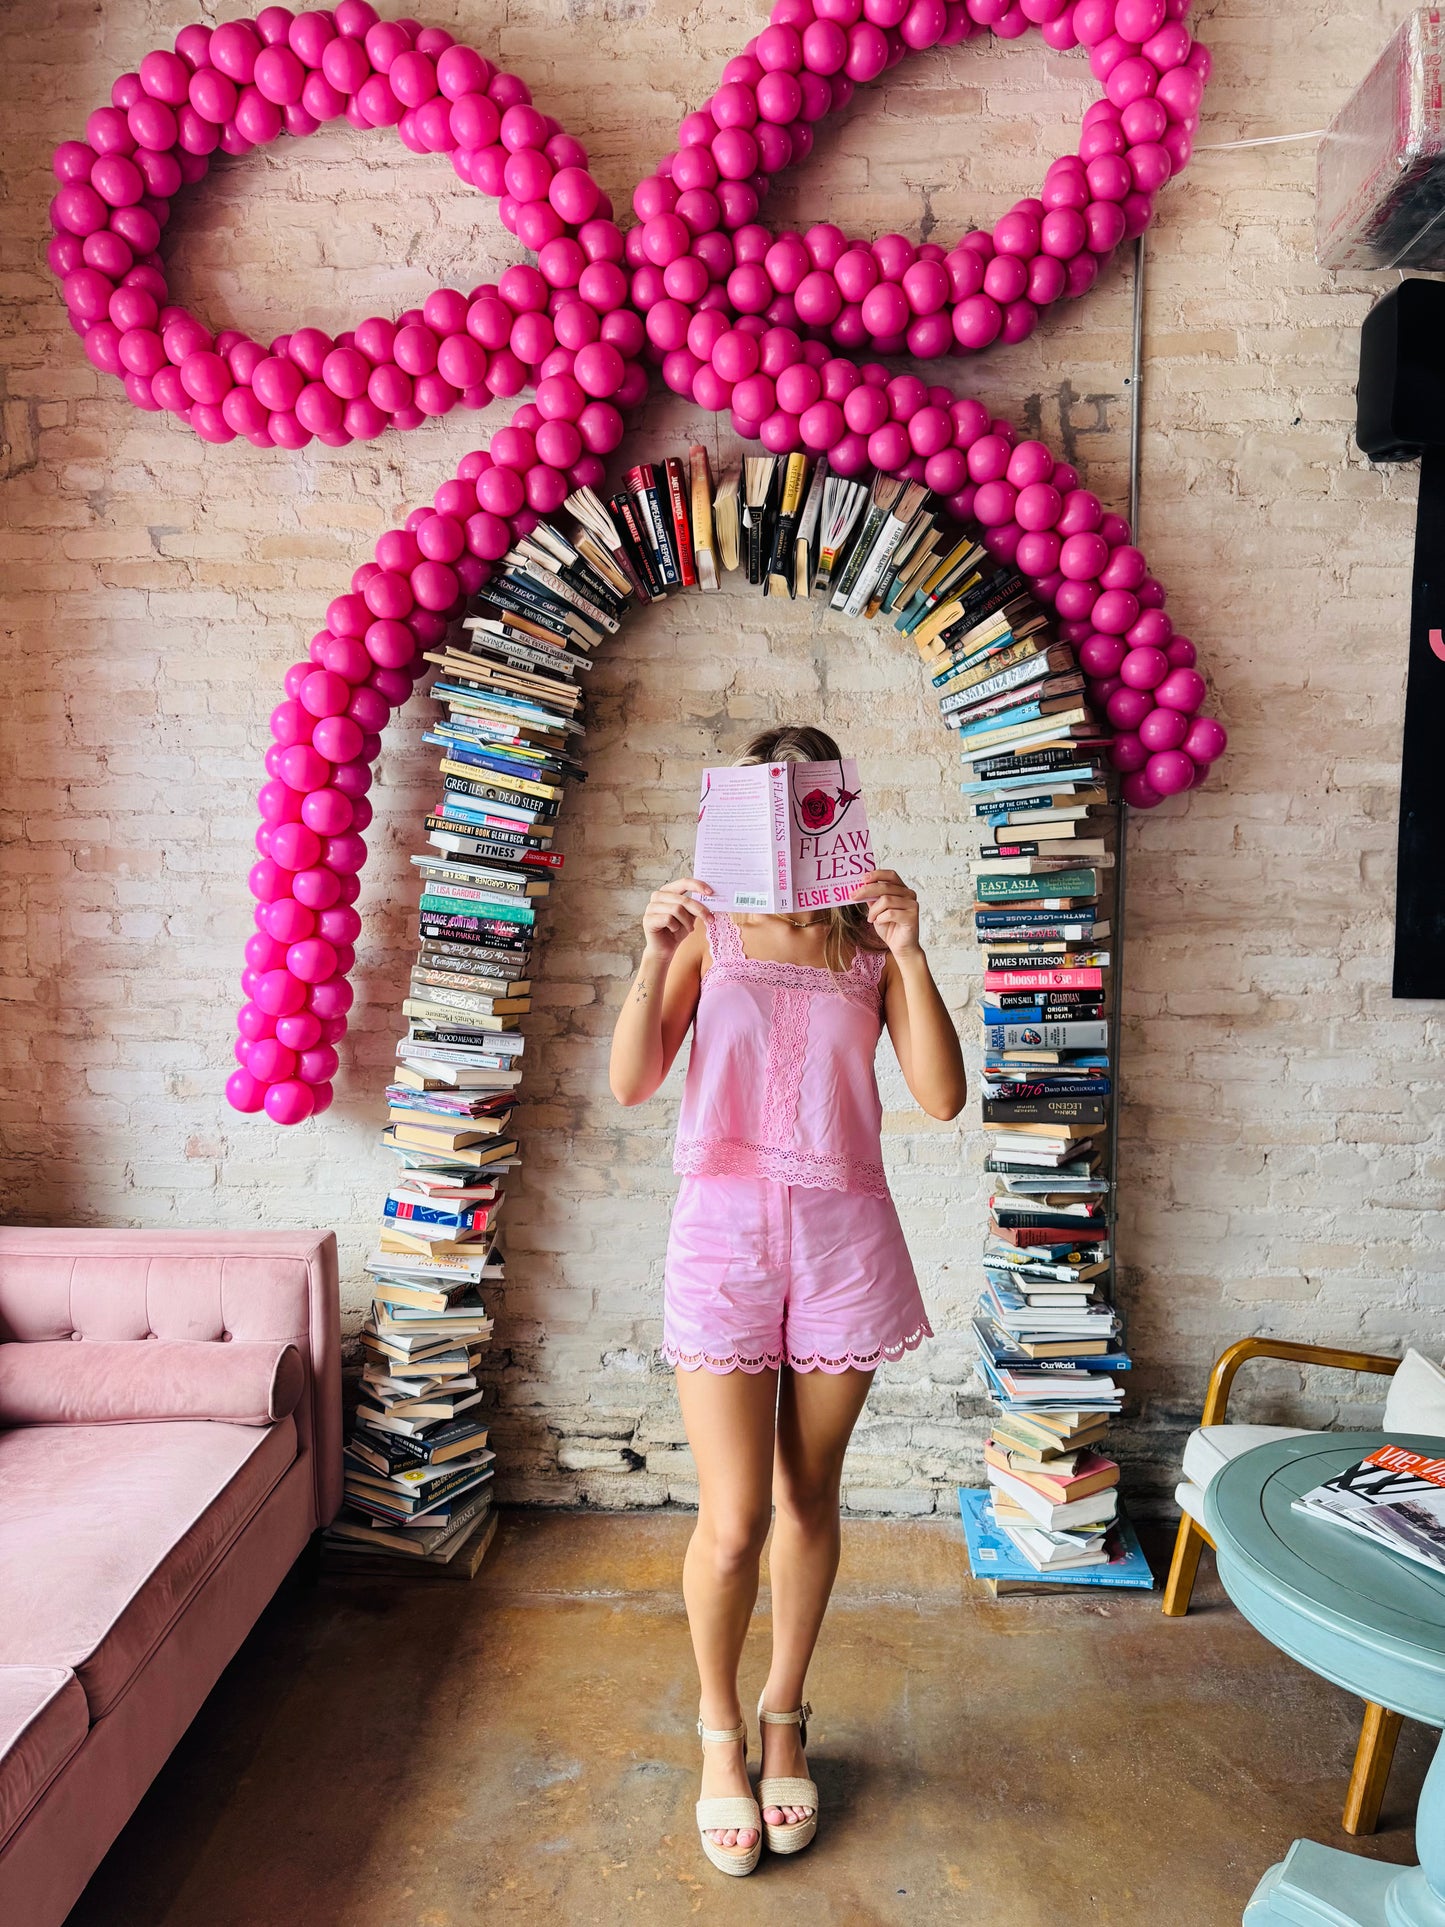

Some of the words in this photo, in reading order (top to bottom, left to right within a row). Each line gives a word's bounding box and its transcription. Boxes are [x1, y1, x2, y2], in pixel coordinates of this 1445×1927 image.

[671, 476, 679, 491] JANET
[787, 464, 797, 498] MELTZER
[621, 504, 634, 523] ANN
[674, 492, 683, 520] EVANOVICH
[627, 520, 641, 544] RULE
[650, 499, 667, 544] IMPEACHMENT
[660, 542, 673, 567] REPORT
[891, 530, 900, 541] LIFE
[883, 545, 892, 555] THE
[874, 553, 887, 573] BALANCE
[514, 586, 538, 601] LEGACY
[541, 571, 566, 593] GOOD
[562, 587, 591, 612] CALORIE
[587, 605, 607, 623] DIET
[1000, 581, 1022, 598] RUTH
[489, 592, 520, 611] Heartbreaker
[982, 595, 1001, 612] WARE
[483, 637, 503, 649] LYING
[504, 641, 523, 655] GAME
[527, 649, 544, 662] RUTH
[545, 655, 561, 668] WARE
[519, 634, 530, 643] REAL
[531, 639, 550, 651] ESTATE
[549, 645, 574, 662] INVESTING
[510, 660, 531, 671] GRANT
[996, 768, 1020, 777] Spectrum
[1020, 764, 1050, 774] DOMINANCE
[445, 777, 468, 794] GREG
[468, 783, 485, 797] ILES
[498, 790, 520, 806] DEAD
[521, 797, 544, 812] SLEEP
[1015, 799, 1028, 807] CIVIL
[773, 781, 786, 842] FLAWLESS
[426, 818, 435, 827] AN
[436, 820, 475, 835] INCONVENIENT
[475, 827, 491, 838] BOOK
[491, 830, 509, 842] GLENN
[509, 833, 524, 845] BECK
[475, 843, 516, 858] FITNESS
[799, 829, 870, 859] FLAW
[777, 850, 786, 866] ELSIE
[816, 852, 877, 882] LESS
[475, 876, 505, 889] GARDNER
[505, 881, 520, 891] LISA
[778, 868, 787, 891] SILVER
[980, 881, 1008, 890] EAST
[1011, 880, 1038, 889] ASIA
[436, 885, 451, 895] LISA
[451, 888, 481, 900] GARDNER
[798, 888, 831, 908] ELSIE
[422, 913, 448, 926] DAMAGE
[448, 915, 479, 930] CONTROL
[498, 924, 520, 934] JANCE
[1005, 914, 1029, 922] CAUSE
[455, 929, 481, 942] PARKER
[1022, 929, 1059, 939] DEAVER
[991, 957, 1017, 968] JAMES
[1019, 955, 1065, 967] PATTERSON
[1003, 973, 1038, 986] Choose
[1038, 974, 1048, 984] to
[1002, 997, 1018, 1005] JOHN
[1018, 996, 1033, 1004] SAUL
[1050, 992, 1080, 1004] GUARDIAN
[425, 1010, 453, 1023] Pleasure
[453, 1015, 475, 1026] King's
[437, 1033, 458, 1042] BLOOD
[458, 1035, 482, 1046] MEMORY
[1016, 1083, 1045, 1098] 1776
[1048, 1102, 1082, 1111] LEGEND
[466, 1213, 474, 1228] VOX
[427, 1485, 447, 1502] Natural
[446, 1476, 468, 1495] Wonders
[440, 1507, 476, 1540] INHERITANCE
